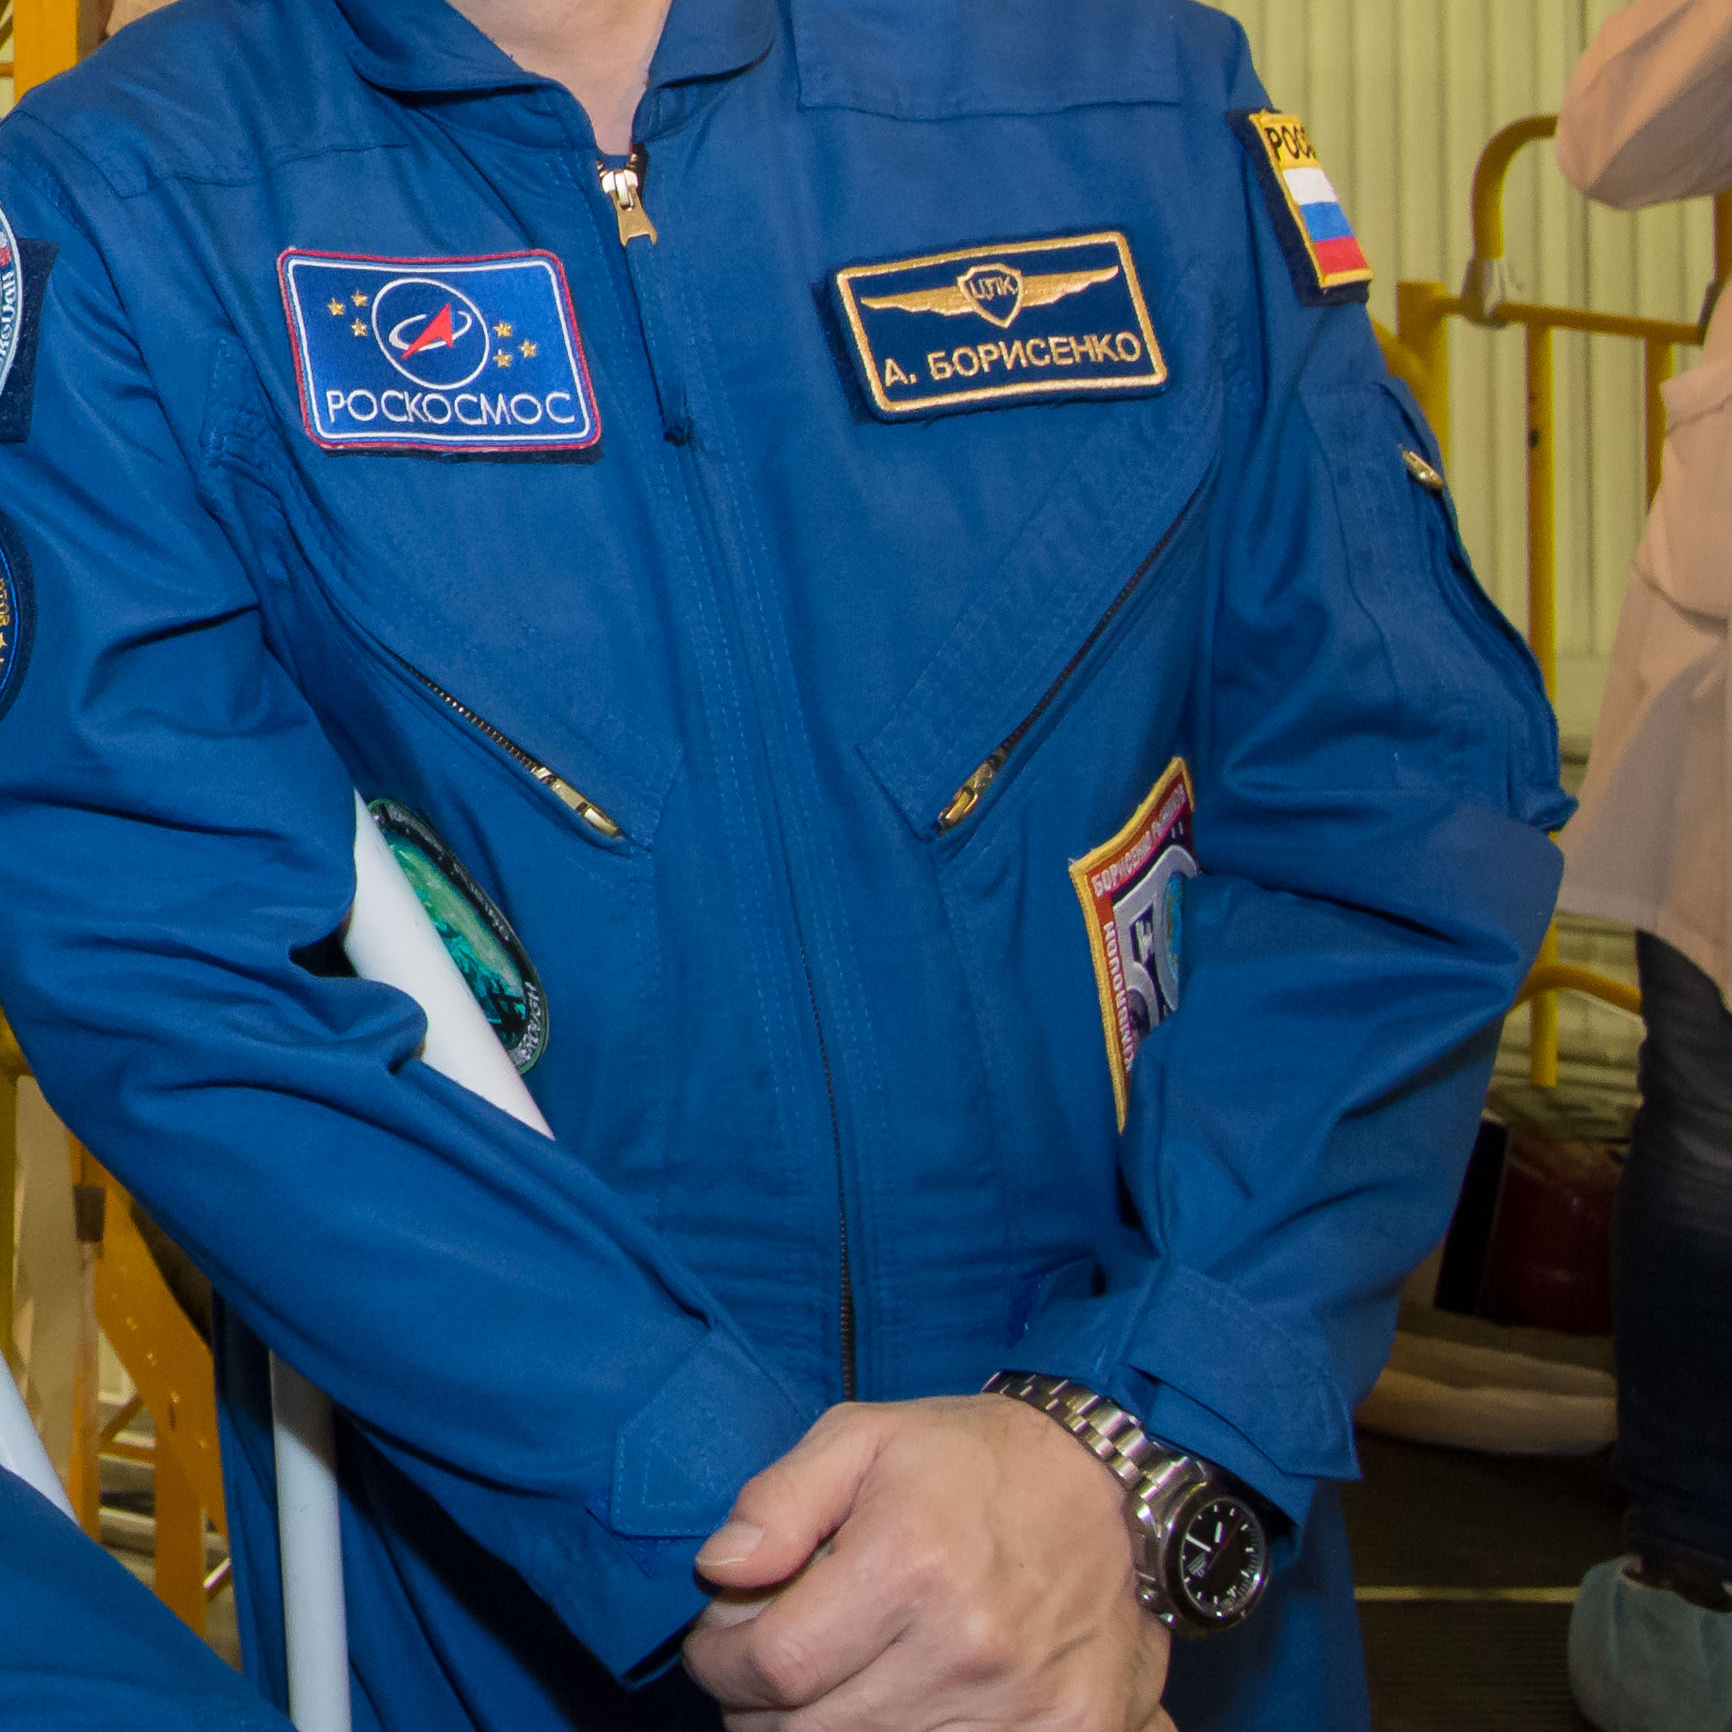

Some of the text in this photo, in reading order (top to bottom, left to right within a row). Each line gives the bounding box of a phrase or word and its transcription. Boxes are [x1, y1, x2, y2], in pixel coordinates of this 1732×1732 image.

[885, 331, 1142, 387] А. БОРИСЕНКО
[326, 389, 576, 426] РОСКОСМОС
